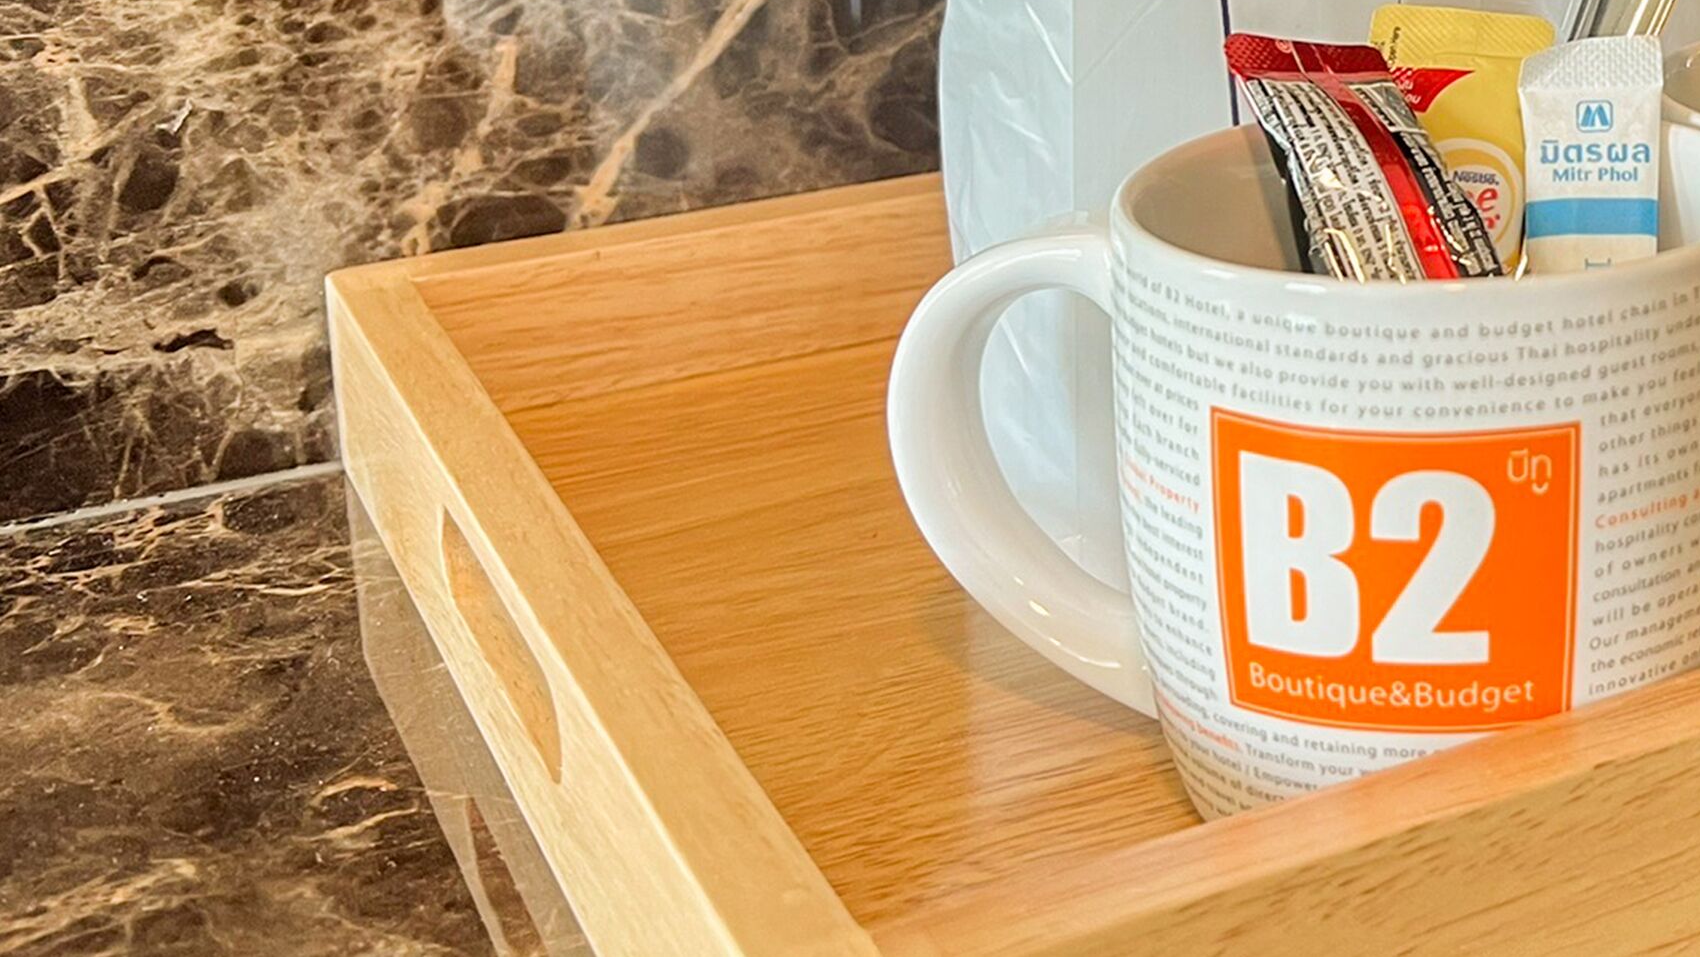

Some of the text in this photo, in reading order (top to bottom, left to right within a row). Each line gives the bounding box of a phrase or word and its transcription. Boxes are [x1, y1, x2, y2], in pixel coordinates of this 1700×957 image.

[1540, 139, 1651, 164] มิตรผล
[1552, 167, 1639, 182] Mitr Phol
[1185, 295, 1668, 342] Hotel, unique boutique and budget hotel chain
[1173, 317, 1660, 369] international standards and gracious Thai hospitality
[1187, 344, 1646, 394] but we also provide you with well-designed guest
[1149, 355, 1226, 394] comfortable
[1231, 382, 1312, 412] facilities
[1320, 398, 1348, 414] for
[1357, 405, 1403, 419] your
[1413, 399, 1546, 418] convenience
[1555, 396, 1575, 409] to
[1582, 386, 1630, 404] make
[1637, 377, 1667, 395] you
[1178, 416, 1198, 434] for
[1600, 408, 1636, 426] that
[1599, 418, 1698, 453] other things
[1598, 439, 1698, 477] has its own
[1597, 468, 1689, 504] apartments
[1595, 493, 1689, 530] Consulting
[1595, 519, 1680, 553] hospitality
[1238, 450, 1497, 664] B2
[1594, 561, 1614, 578] of
[1622, 545, 1683, 571] owners
[1592, 568, 1681, 603] consultation
[1592, 607, 1625, 626] will
[1631, 600, 1652, 616] be
[1588, 633, 1620, 651] Our
[1590, 633, 1686, 673] the economic
[1249, 661, 1536, 712] Boutique&Budget
[1588, 660, 1677, 695] innovative
[1212, 711, 1427, 760] covering and retaining more
[1245, 743, 1354, 777] Transform your
